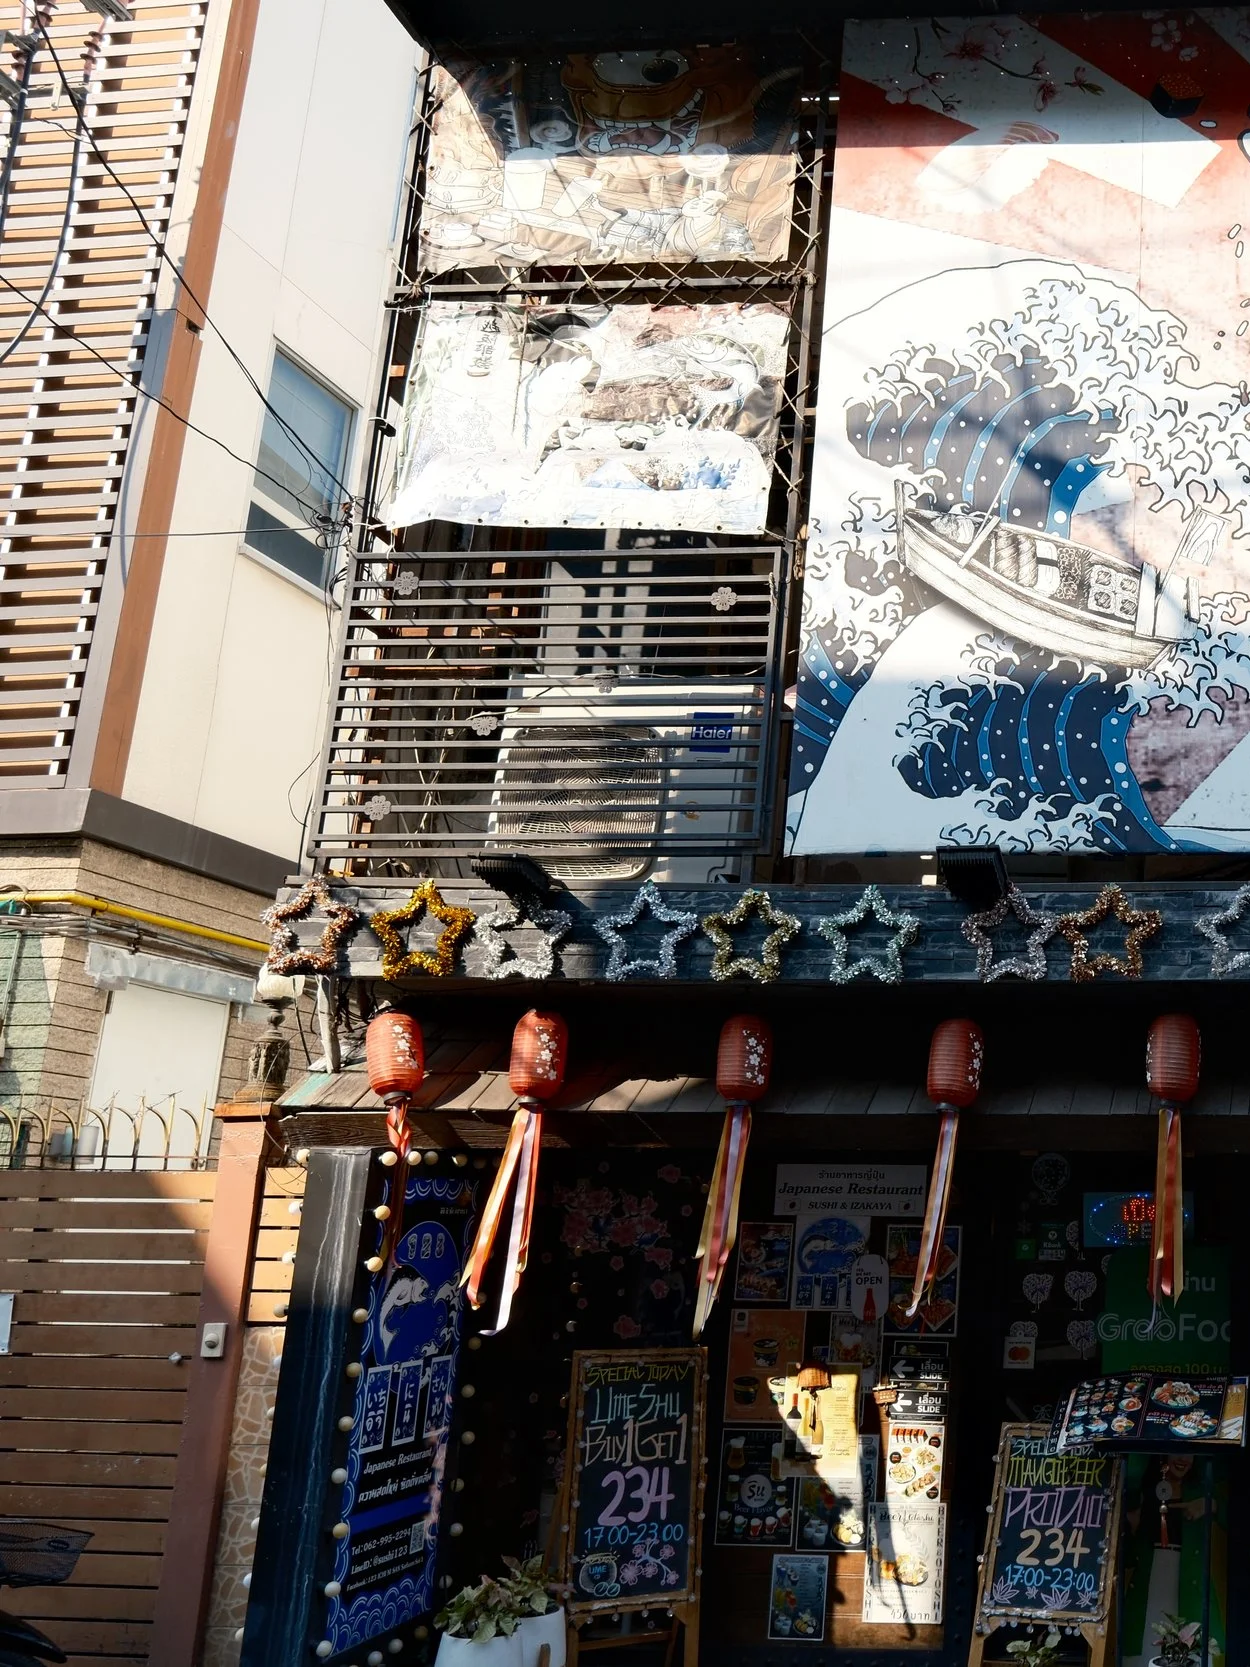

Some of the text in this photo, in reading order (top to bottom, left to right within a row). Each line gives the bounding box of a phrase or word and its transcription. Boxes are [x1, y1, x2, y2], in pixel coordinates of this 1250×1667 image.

[691, 725, 732, 739] Haier
[818, 1168, 885, 1181] ร้านอาหารญี่ปุ่น
[778, 1182, 924, 1196] Japanese Restaurant
[807, 1201, 892, 1211] SUSHI & IZAKAYA
[855, 1276, 883, 1285] OPEN
[587, 1364, 690, 1386] SPECIAL TODAY
[404, 1382, 415, 1401] に
[431, 1375, 447, 1393] さん
[367, 1388, 387, 1409] いち
[363, 1447, 433, 1475] Japanese Restaurant
[597, 1465, 676, 1527] 234
[734, 1503, 774, 1514] Beer Flavor
[880, 1511, 903, 1522] Beer
[1015, 1529, 1091, 1568] 234
[588, 1565, 608, 1574] UME
[1004, 1565, 1095, 1591] 17:00-23:00
